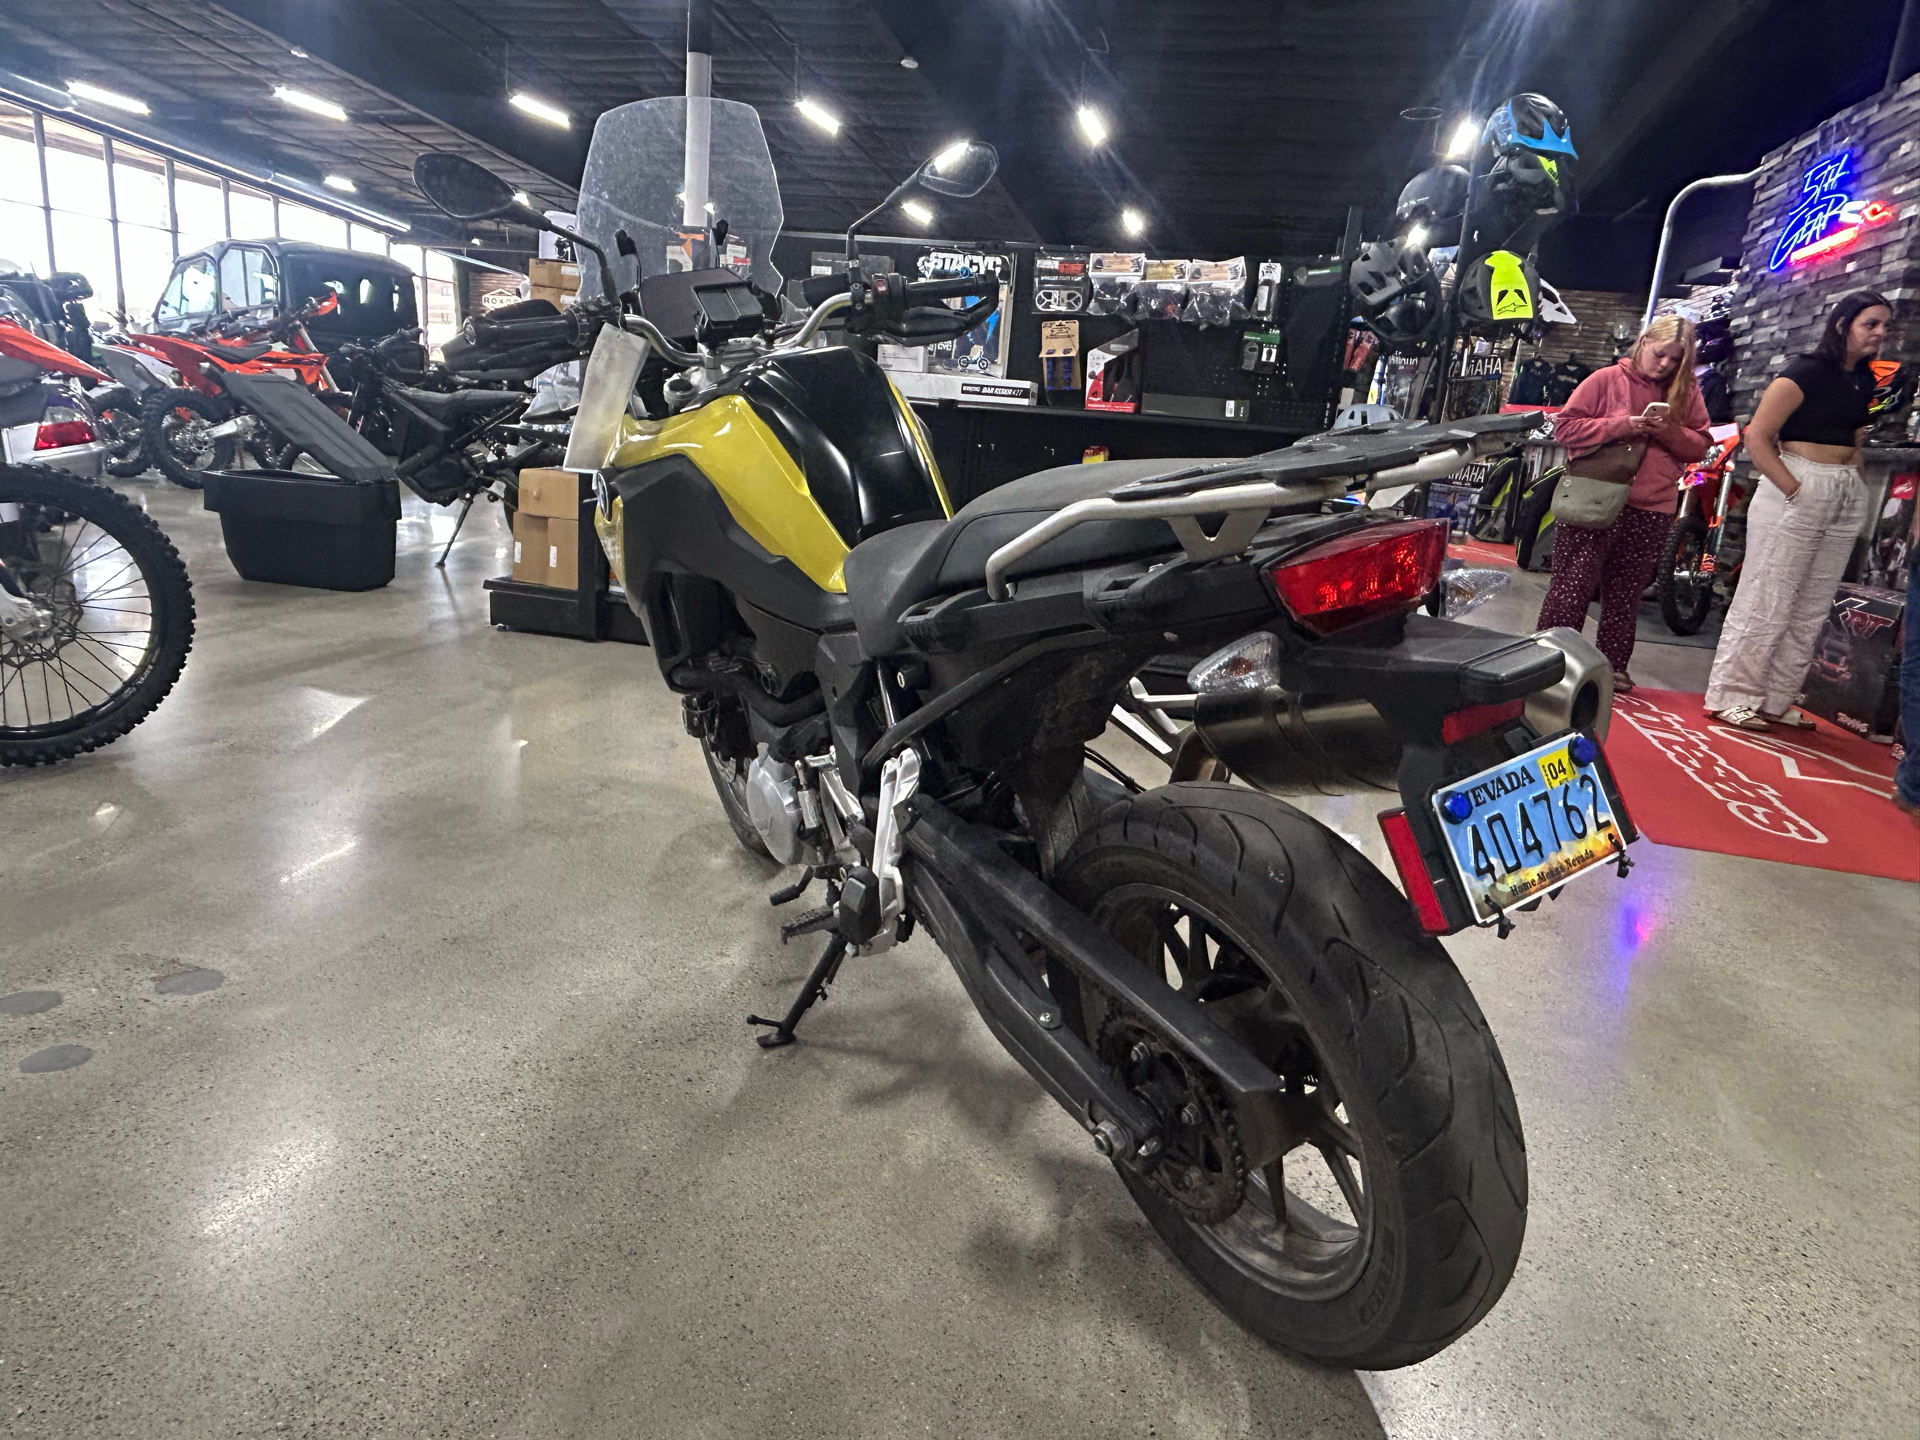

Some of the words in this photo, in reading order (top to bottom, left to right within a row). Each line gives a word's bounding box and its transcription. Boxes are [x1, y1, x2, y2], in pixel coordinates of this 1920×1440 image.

[1448, 465, 1485, 483] MAHA
[1548, 757, 1567, 781] 04
[1471, 774, 1611, 882] 404762
[1509, 878, 1537, 897] Home
[1565, 849, 1595, 871] Nevada
